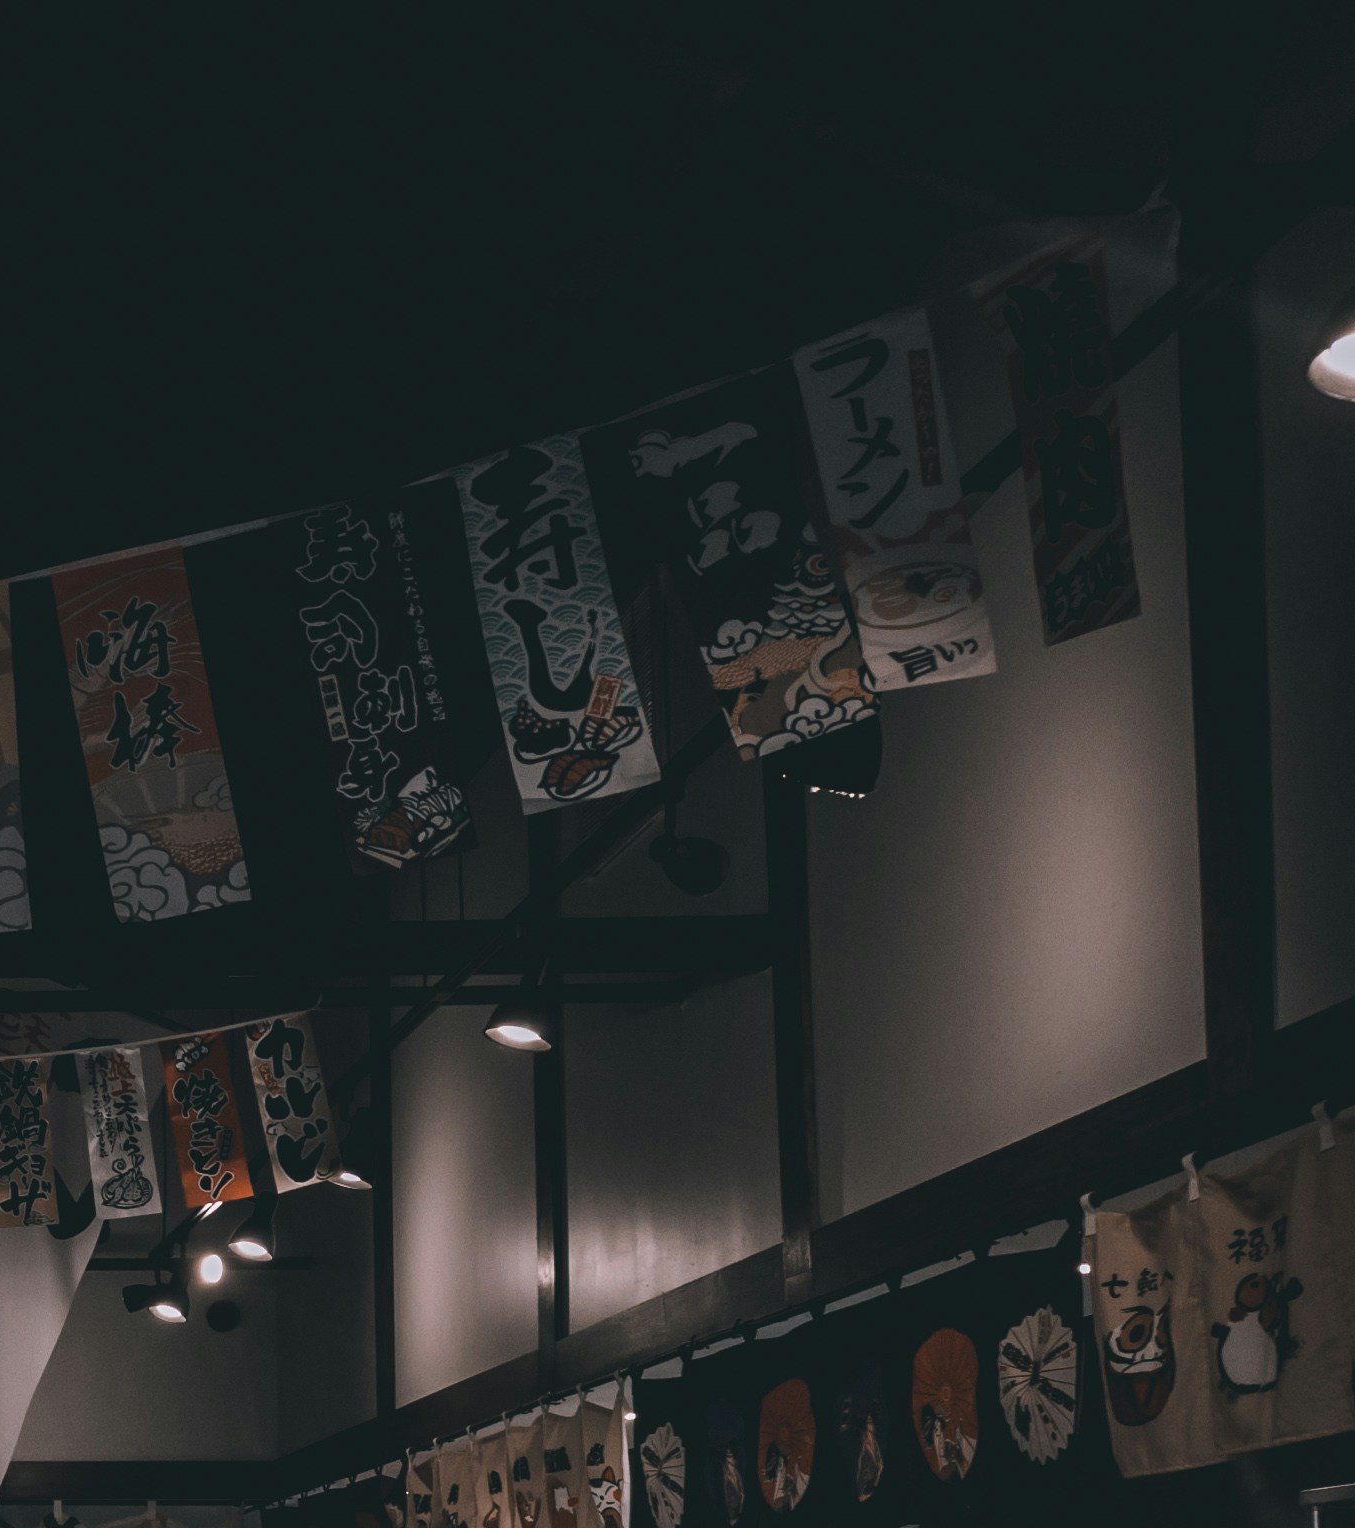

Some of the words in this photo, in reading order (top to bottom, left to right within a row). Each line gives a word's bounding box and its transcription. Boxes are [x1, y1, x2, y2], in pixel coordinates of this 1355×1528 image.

[810, 333, 910, 529] ラーメン
[471, 442, 601, 712] 寿し
[255, 1018, 327, 1183] カルビ
